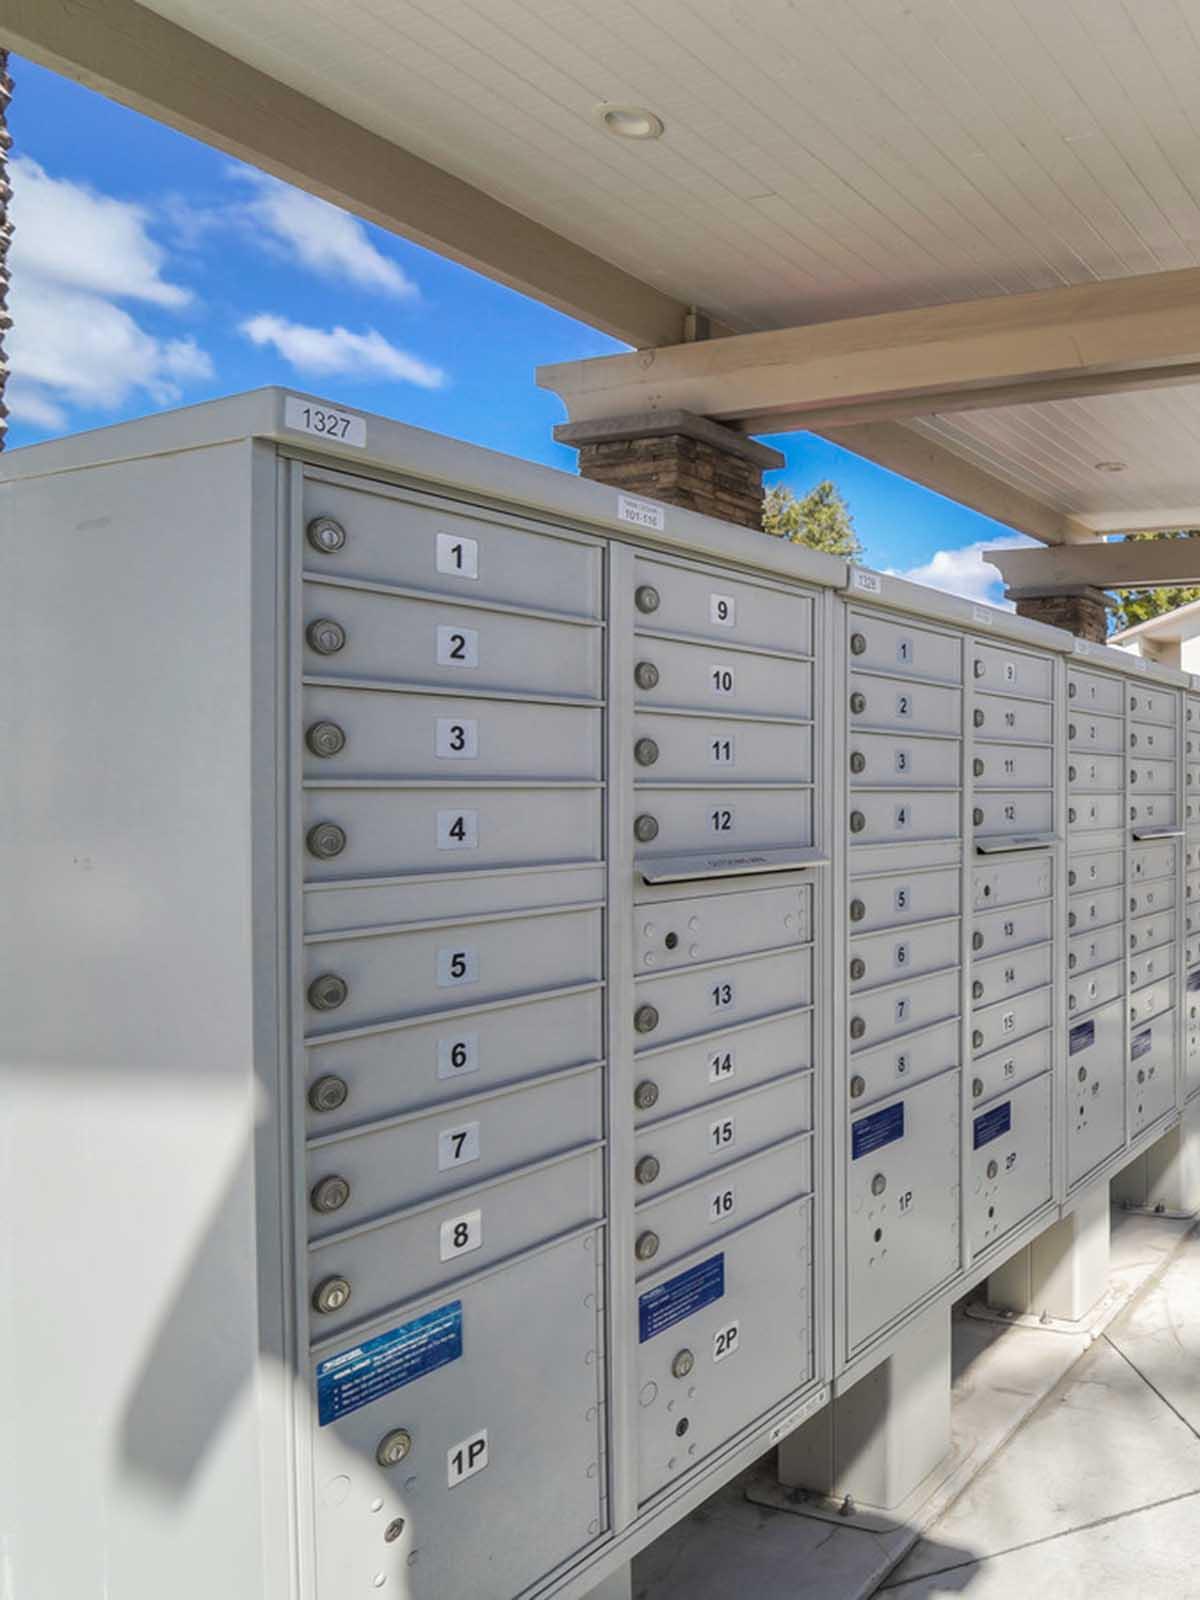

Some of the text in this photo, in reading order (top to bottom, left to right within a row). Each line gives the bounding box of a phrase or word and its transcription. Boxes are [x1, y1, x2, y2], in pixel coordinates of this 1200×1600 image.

[302, 408, 351, 439] 1327
[451, 543, 462, 569] 1
[717, 600, 728, 621] 9
[449, 634, 466, 660] 2
[901, 643, 907, 659] 1
[712, 670, 733, 692] 10
[1006, 667, 1013, 680] 9
[900, 697, 907, 714] 2
[449, 725, 465, 751] 3
[712, 740, 730, 761] 11
[898, 753, 906, 770] 3
[1004, 759, 1014, 773] 11
[712, 810, 732, 831] 12
[897, 809, 905, 824] 4
[1004, 805, 1015, 820] 12
[449, 816, 466, 842] 4
[898, 891, 906, 908] 5
[1003, 922, 1014, 936] 13
[450, 952, 467, 978] 5
[897, 946, 905, 963] 6
[712, 984, 732, 1006] 13
[897, 1000, 905, 1017] 7
[1003, 1015, 1014, 1030] 15
[451, 1042, 467, 1068] 6
[712, 1053, 732, 1076] 14
[897, 1056, 905, 1073] 8
[712, 1121, 733, 1145] 15
[451, 1131, 467, 1159] 7
[713, 1191, 733, 1215] 16
[899, 1191, 913, 1211] 1P
[453, 1222, 469, 1249] 8
[715, 1327, 738, 1356] 2P
[451, 1438, 487, 1477] 1P
